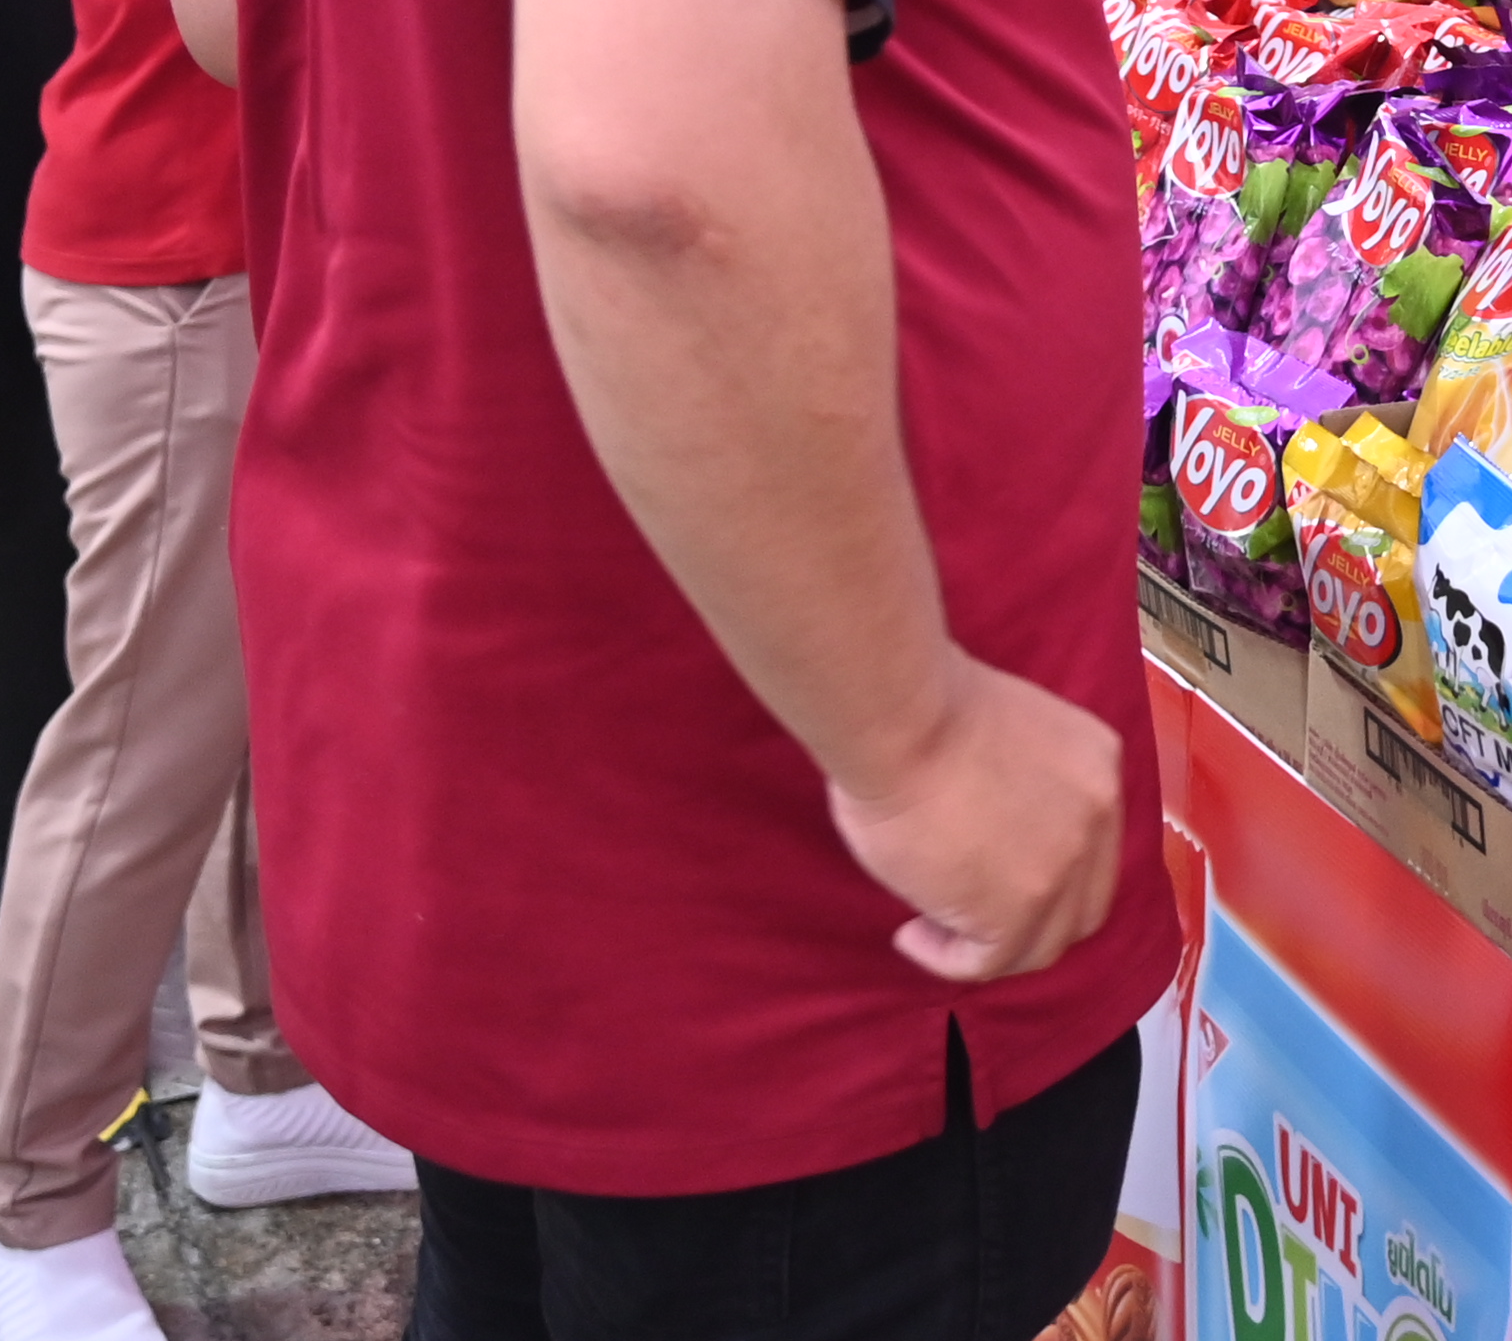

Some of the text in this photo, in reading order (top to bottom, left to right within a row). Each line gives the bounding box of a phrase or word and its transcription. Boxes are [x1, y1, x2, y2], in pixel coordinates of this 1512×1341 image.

[1283, 21, 1323, 43] JELLY
[1160, 90, 1242, 187] Yoyo
[1208, 101, 1236, 119] JELLY
[1444, 142, 1489, 163] JELLY
[1322, 129, 1421, 252] Yoyo
[1170, 387, 1267, 515] Yoyo
[1212, 423, 1262, 457] JELLY
[1292, 512, 1386, 646] Yoyo
[1325, 552, 1371, 588] JELLY
[1278, 1122, 1358, 1279] UNI
